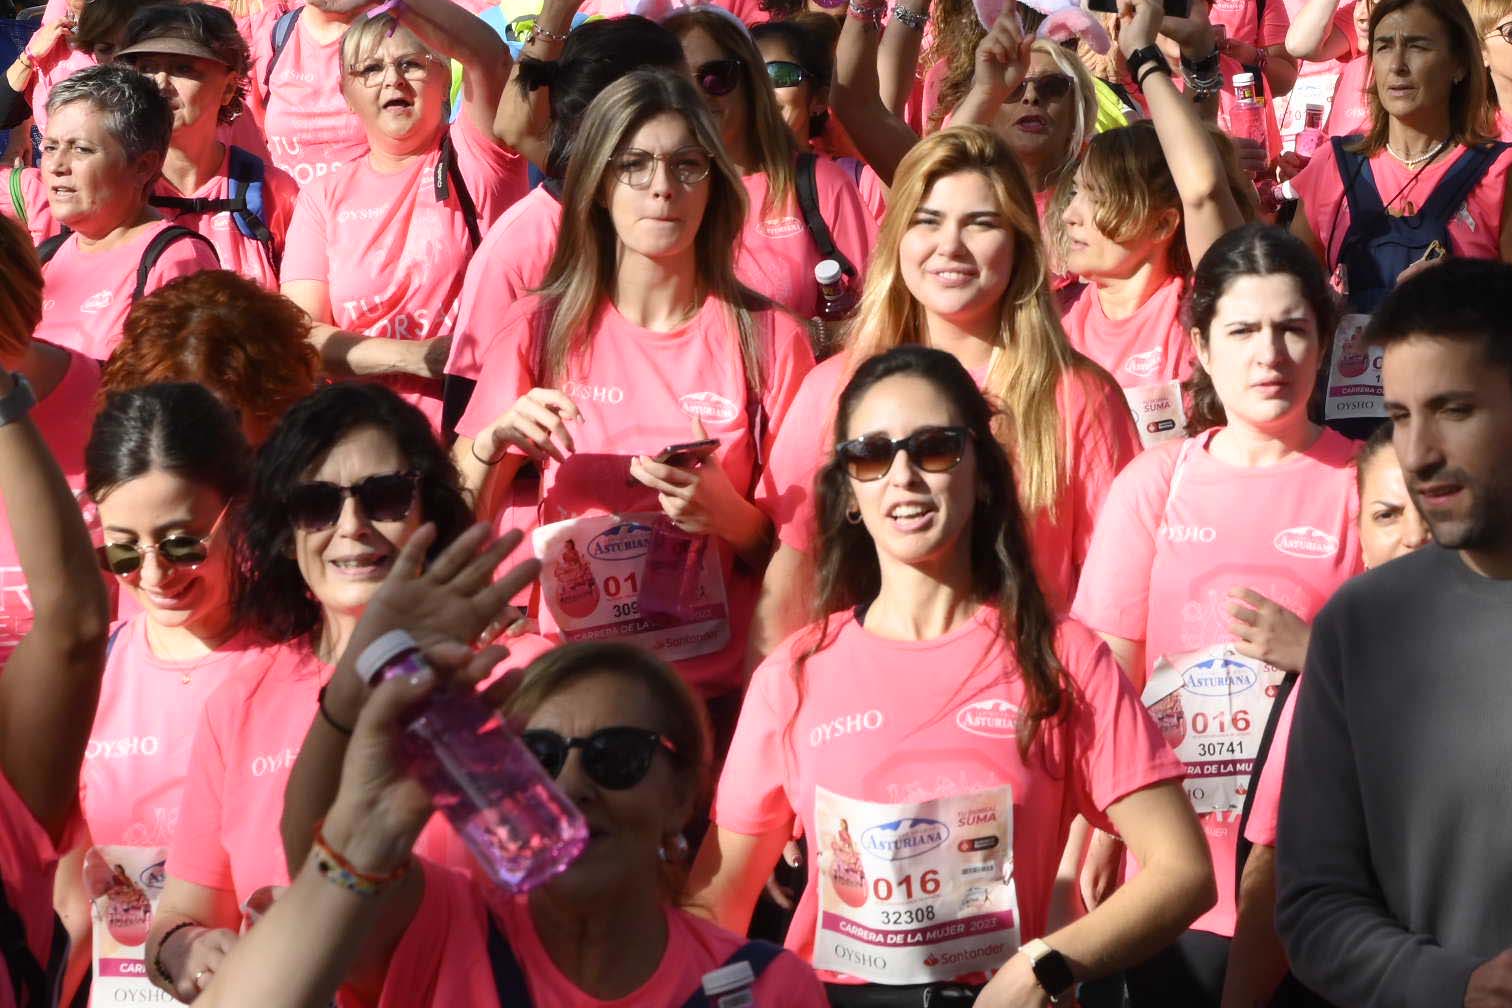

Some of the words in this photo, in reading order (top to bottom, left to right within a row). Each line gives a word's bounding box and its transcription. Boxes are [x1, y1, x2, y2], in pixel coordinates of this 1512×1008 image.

[603, 571, 638, 597] 01
[612, 600, 639, 619] 309
[1187, 673, 1250, 689] ASTURIANA
[810, 708, 883, 747] OYSHO
[1191, 709, 1251, 735] 016
[84, 735, 159, 759] OYSHO
[1198, 741, 1244, 757] 30741
[1204, 763, 1218, 774] DE
[1220, 763, 1234, 773] LA
[1236, 762, 1253, 772] MU
[958, 812, 997, 828] SUMA
[869, 831, 943, 851] ASTURIANA
[873, 869, 941, 901] 016
[881, 905, 936, 926] 32308
[839, 921, 884, 943] CARRERA
[886, 933, 905, 944] DE
[907, 929, 923, 943] LA
[926, 922, 964, 941] MUJER
[970, 917, 997, 931] 2023
[834, 943, 887, 970] OYSHO
[940, 943, 1006, 965] Santander
